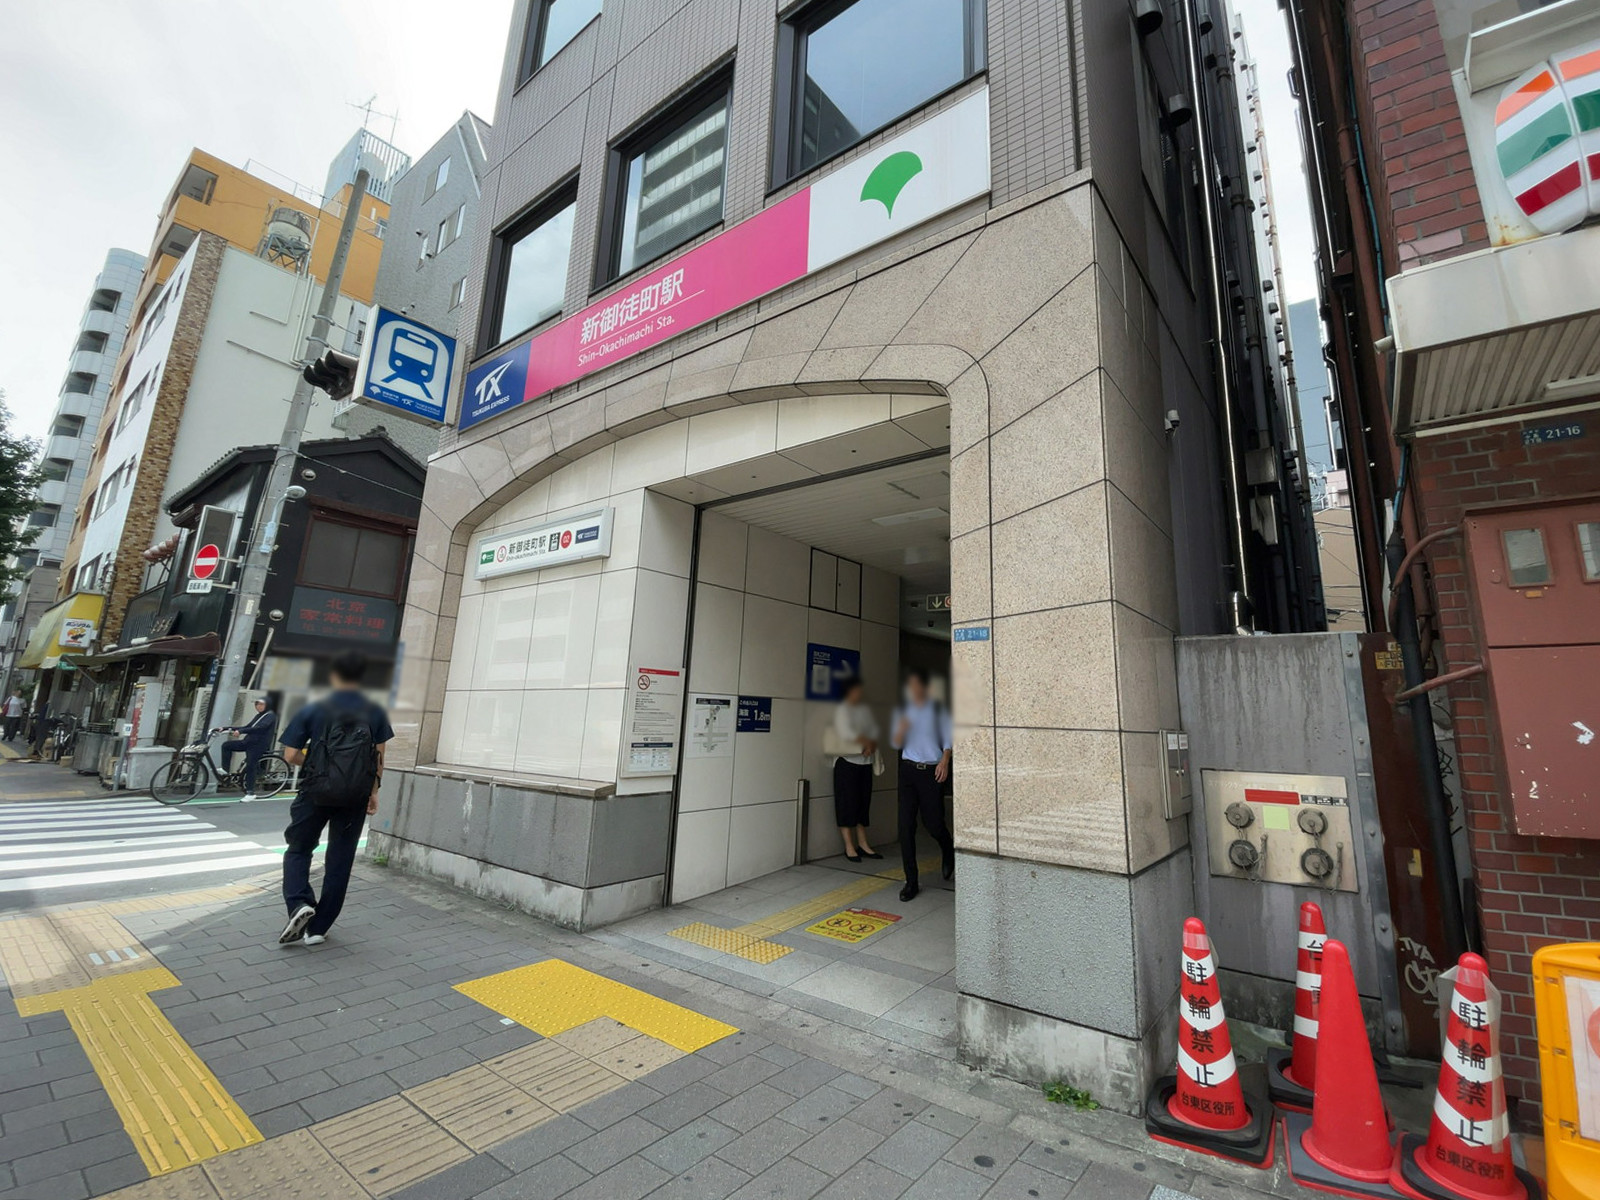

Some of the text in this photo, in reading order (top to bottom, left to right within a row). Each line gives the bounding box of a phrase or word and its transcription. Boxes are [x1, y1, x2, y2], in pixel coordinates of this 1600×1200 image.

[580, 268, 684, 344] 新御徒町駅
[577, 315, 675, 367] Shin-Okachimachi Sta.
[475, 360, 514, 405] TX
[490, 394, 510, 410] EXPRESS
[1546, 425, 1581, 439] 21-16
[508, 535, 547, 555] 新御徒町駅
[754, 709, 770, 721] 1.8m
[1186, 961, 1217, 1088] 駐輪禁止
[1455, 1001, 1488, 1146] 駐輪禁止
[1181, 1091, 1235, 1116] 台東区役所
[1435, 1145, 1505, 1180] 台東区役所
